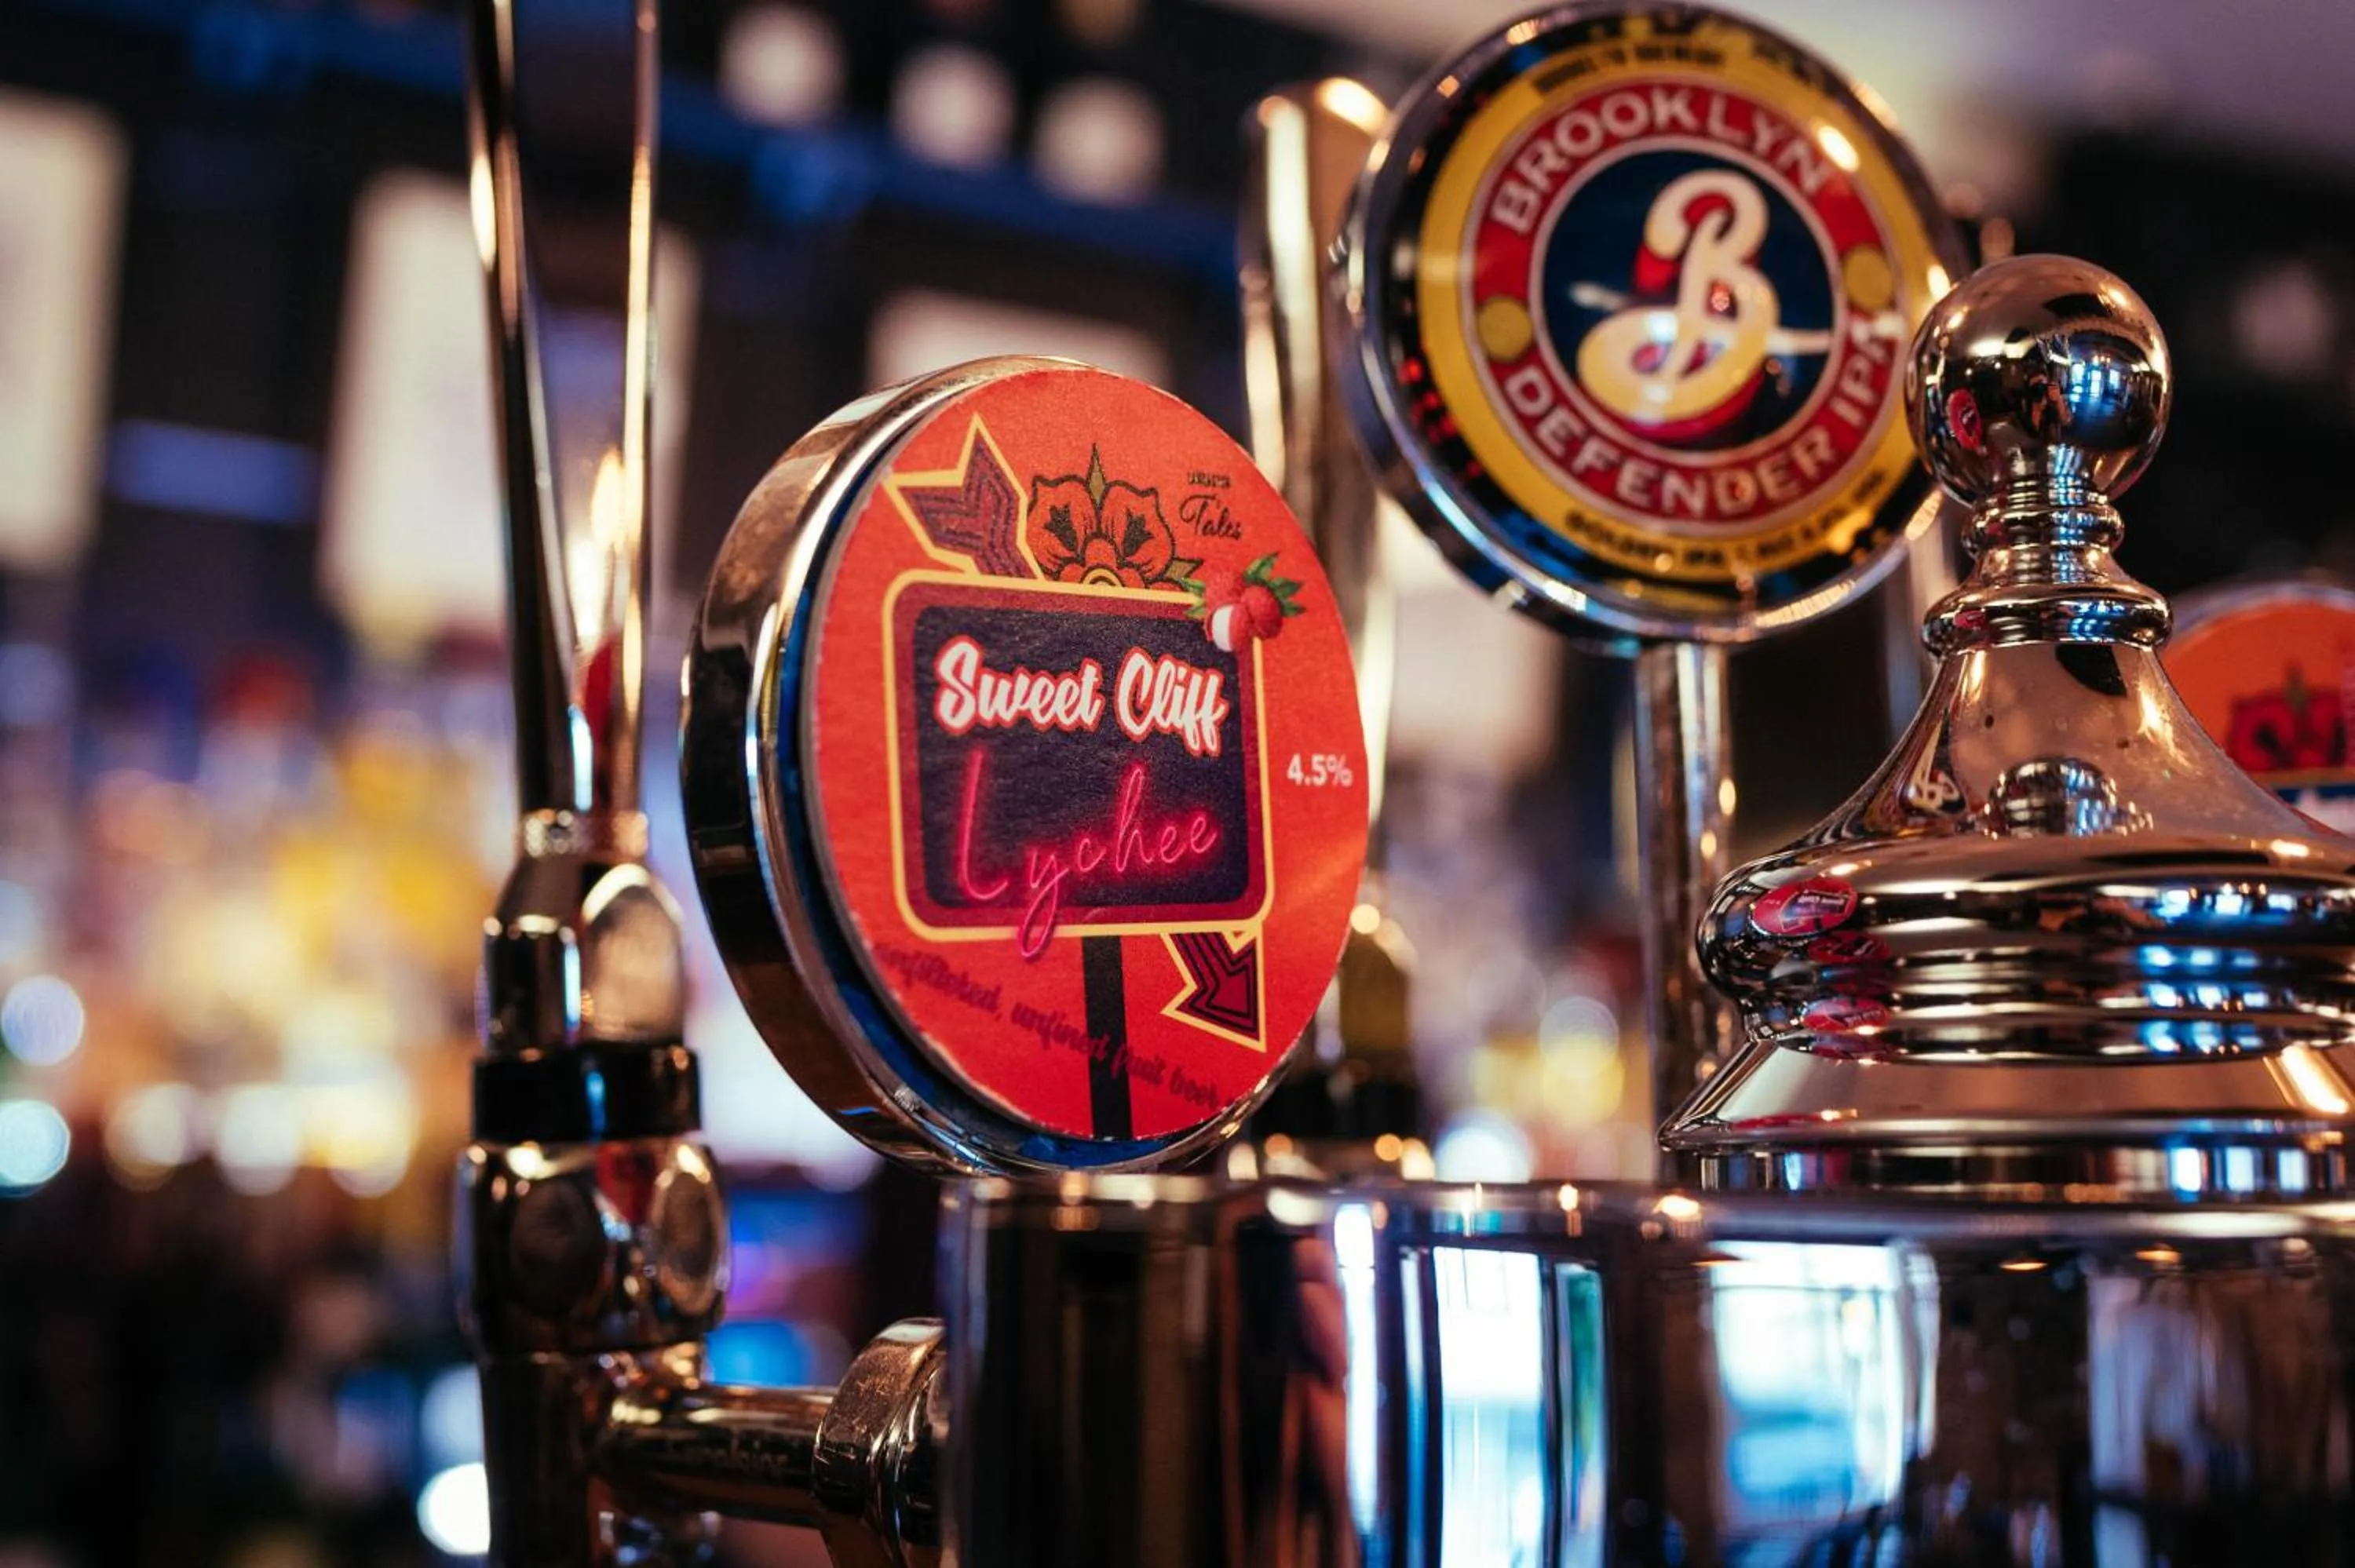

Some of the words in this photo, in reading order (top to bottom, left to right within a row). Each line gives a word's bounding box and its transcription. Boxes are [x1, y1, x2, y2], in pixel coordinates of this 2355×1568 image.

[1492, 86, 1837, 234] BROOKLYN
[1503, 366, 1837, 519] DEFENDER
[1830, 312, 1905, 428] IPA
[1179, 494, 1241, 540] Tales
[937, 638, 1102, 731] Sweet
[1117, 650, 1227, 755] Cliff
[1287, 753, 1353, 787] 4.5%
[961, 749, 1218, 958] Lychee
